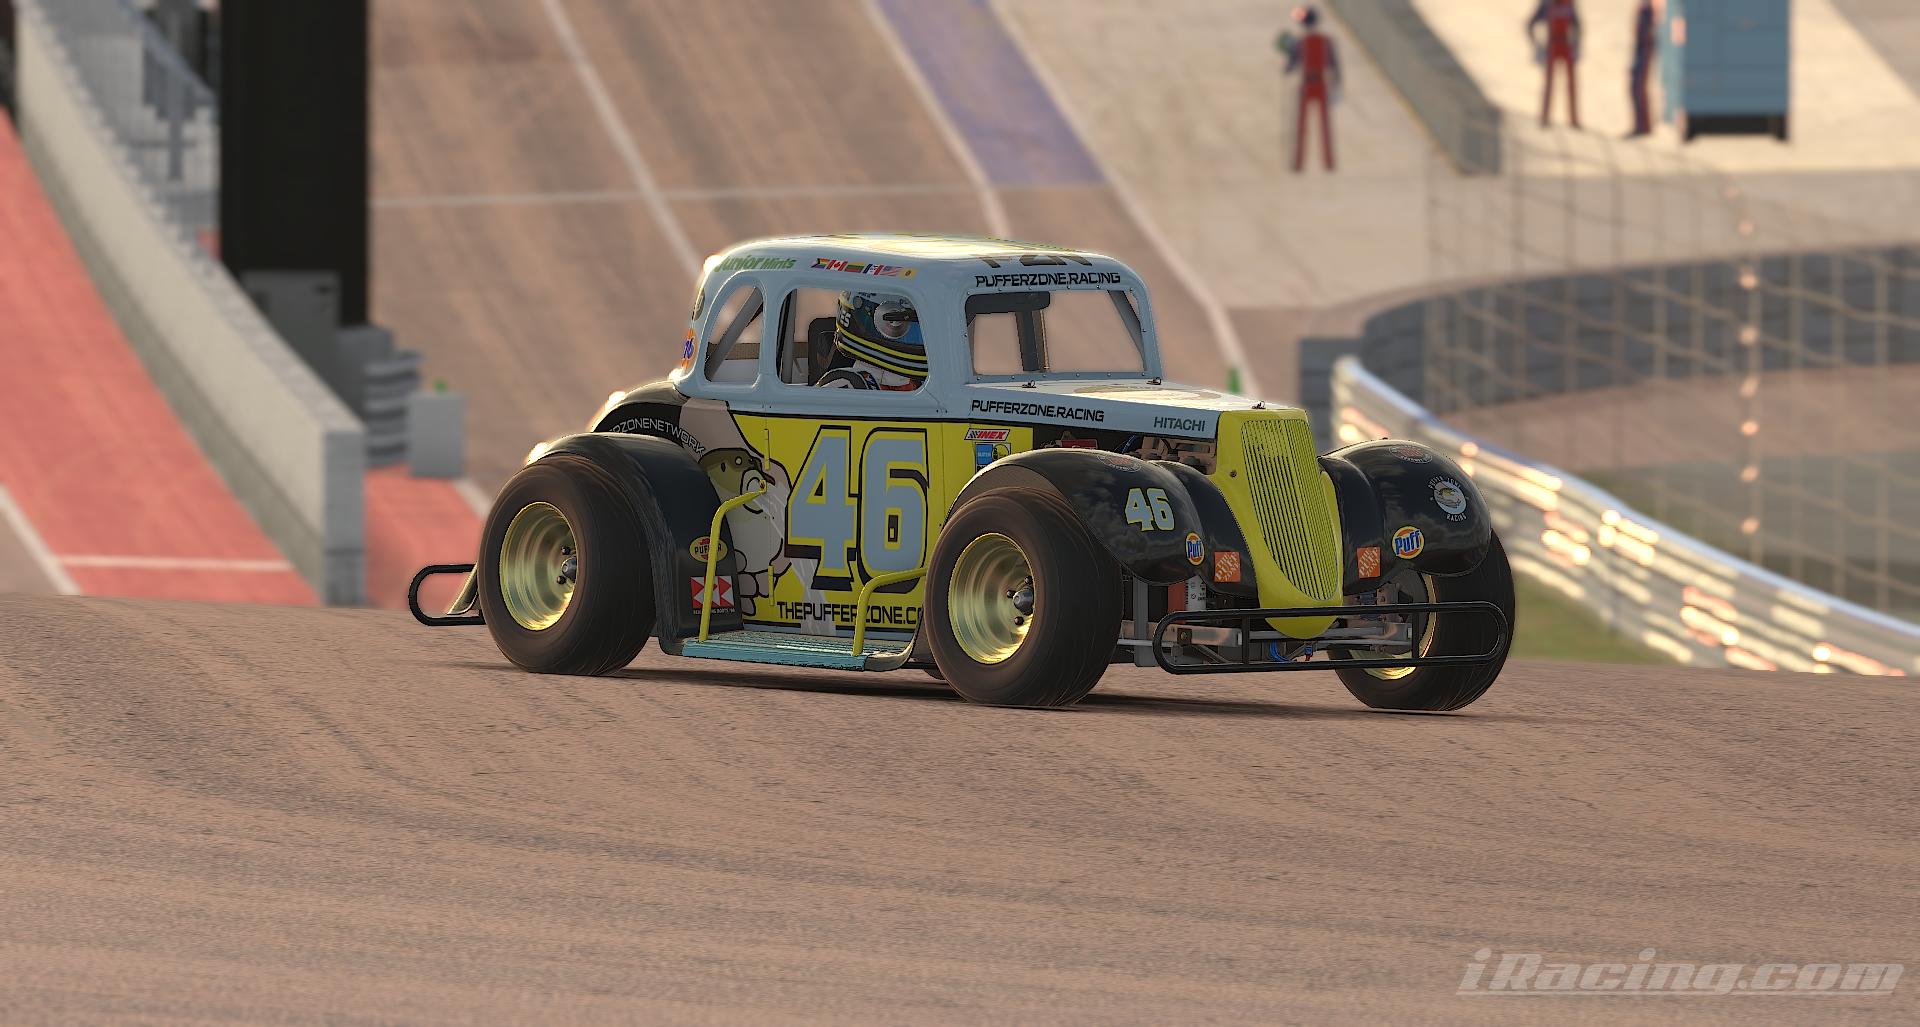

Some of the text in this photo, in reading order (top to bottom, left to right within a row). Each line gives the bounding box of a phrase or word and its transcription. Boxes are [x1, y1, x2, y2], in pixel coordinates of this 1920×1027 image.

[975, 272, 1121, 288] PUFFERZONE.RACING
[971, 400, 1104, 422] PUFFERZONE.RACING
[976, 430, 1006, 440] INEX
[1153, 416, 1206, 432] HITACHI
[784, 425, 930, 594] 46
[1125, 487, 1175, 532] 46
[1393, 529, 1420, 557] Puff
